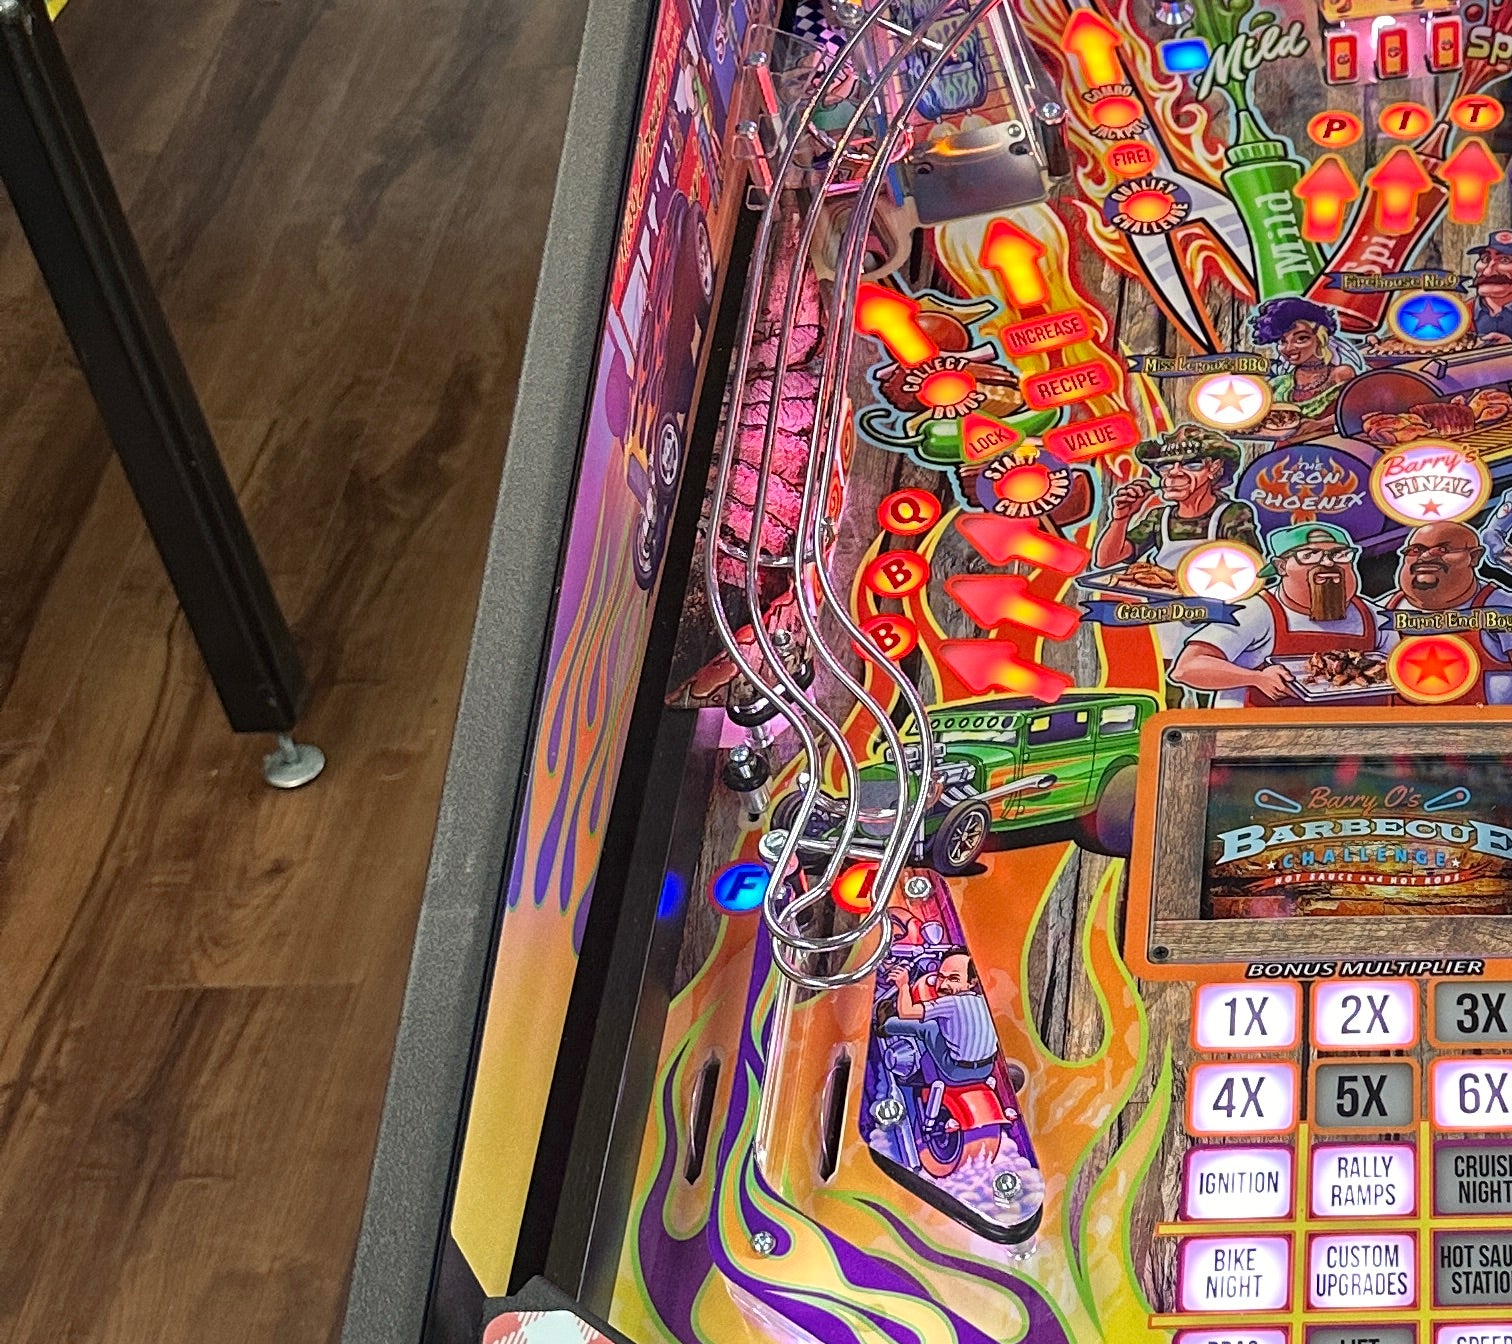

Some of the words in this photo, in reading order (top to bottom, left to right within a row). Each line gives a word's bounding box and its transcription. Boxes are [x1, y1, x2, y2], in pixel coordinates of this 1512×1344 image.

[1195, 22, 1309, 101] Mild
[1112, 148, 1152, 167] FIRE!
[1110, 176, 1178, 203] QUALIFY
[1008, 316, 1085, 349] INCREASE
[1143, 357, 1175, 374] Miss
[1238, 357, 1270, 373] BBQ
[1036, 368, 1101, 401] RECIPE
[969, 428, 1010, 455] LOCK
[1063, 423, 1119, 453] VALUE
[1297, 460, 1325, 473] THE
[1384, 443, 1481, 478] Barry's
[1277, 468, 1342, 485] IRON
[1384, 474, 1476, 500] FINAL
[1250, 487, 1367, 512] PHOENIX
[1116, 604, 1168, 621] Gator
[1171, 603, 1206, 619] Don
[1395, 611, 1444, 630] Burnt
[1446, 611, 1479, 629] End
[1306, 785, 1378, 817] Barry
[1383, 784, 1423, 808] O's
[1281, 848, 1447, 870] CHALLENGE
[1273, 874, 1301, 886] HOT
[1309, 871, 1353, 883] SAUCE
[1389, 875, 1417, 886] HOT
[1247, 961, 1334, 978] BONUS
[1341, 959, 1484, 976] MULTIPLIER
[1223, 995, 1269, 1038] 1X
[1340, 993, 1391, 1035] 2X
[1456, 992, 1508, 1034] 3X
[1212, 1075, 1265, 1119] 4X
[1336, 1074, 1389, 1118] 5X
[1458, 1071, 1511, 1114] 6X
[1336, 1154, 1394, 1180] RALLY
[1198, 1170, 1280, 1196] IGNITION
[1330, 1182, 1397, 1208] RAMPS
[1213, 1247, 1257, 1273] BIKE
[1325, 1243, 1401, 1270] CUSTOM
[1439, 1245, 1475, 1271] HOT
[1205, 1274, 1264, 1301] NIGHT
[1315, 1271, 1409, 1298] UPGRADES
